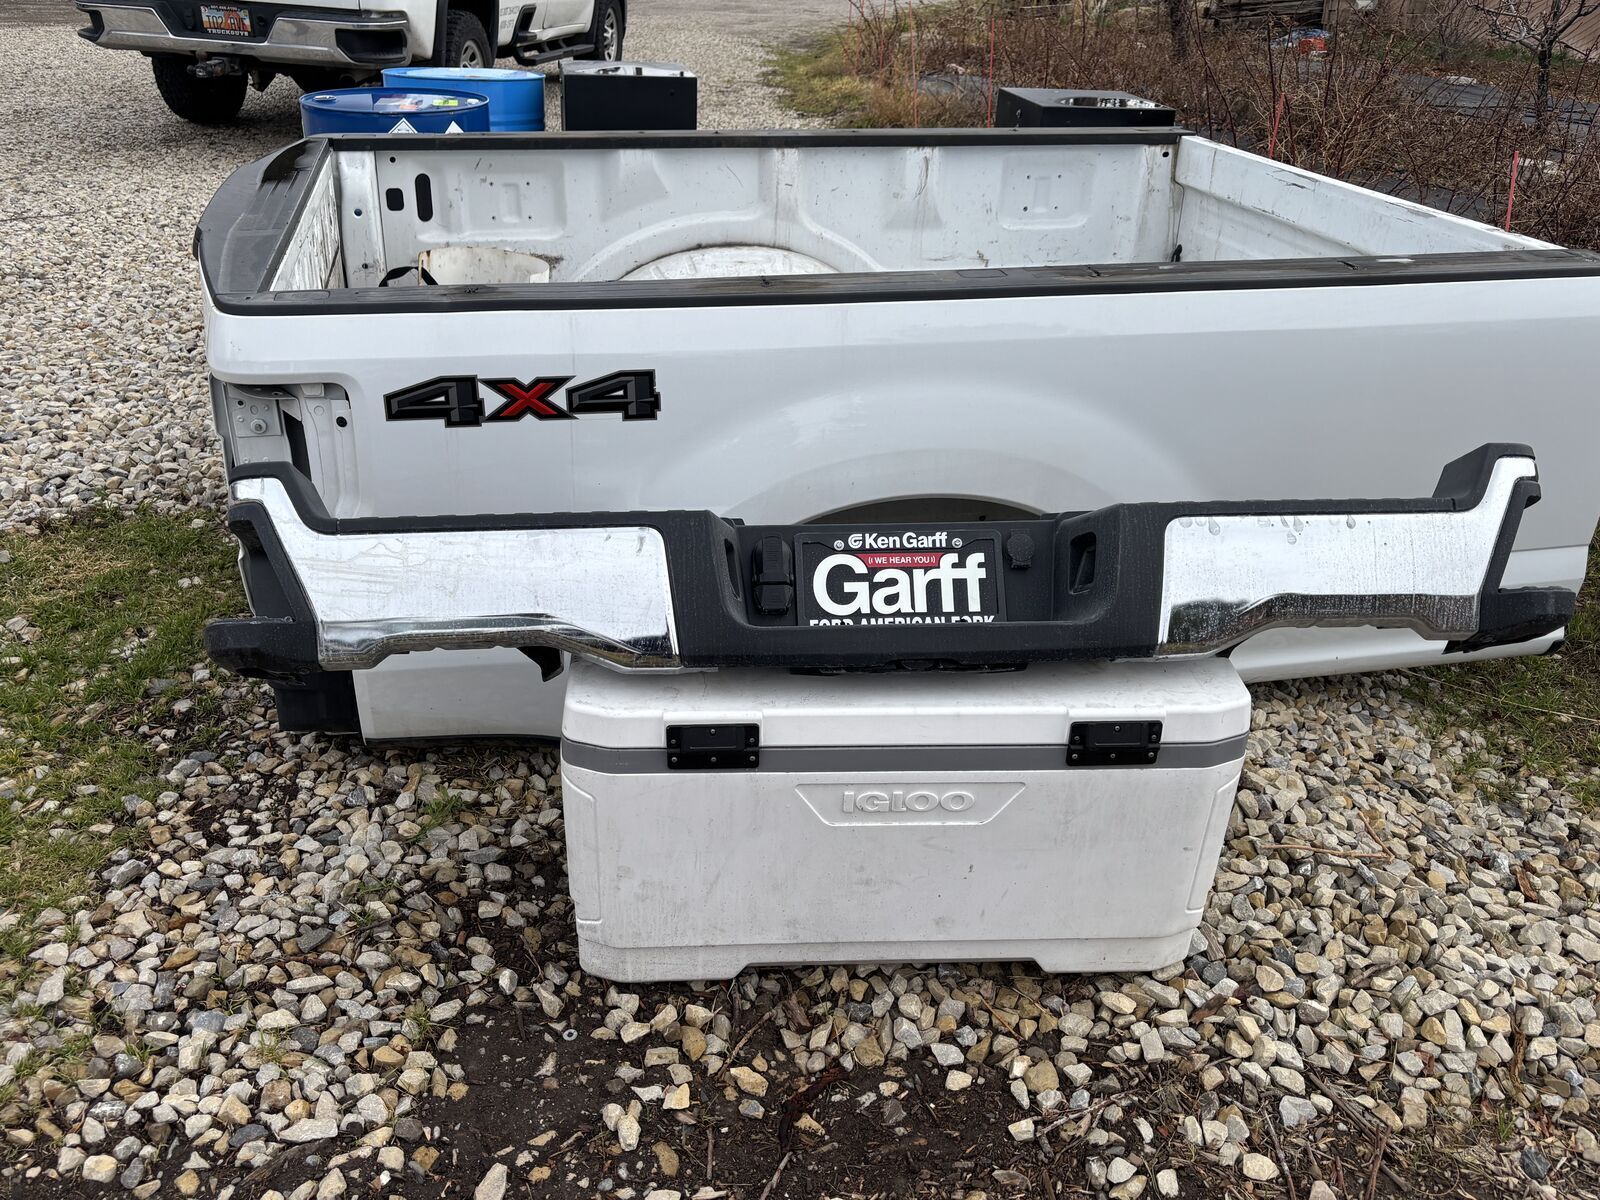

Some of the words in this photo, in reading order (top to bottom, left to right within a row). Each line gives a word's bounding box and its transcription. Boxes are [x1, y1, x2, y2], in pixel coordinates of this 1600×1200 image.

[864, 532, 900, 549] Ken
[902, 531, 948, 548] Garff
[874, 556, 888, 564] WE
[889, 556, 912, 564] HEAR
[913, 556, 930, 564] YOU
[812, 552, 987, 616] Garff
[842, 791, 976, 813] IGLOO
